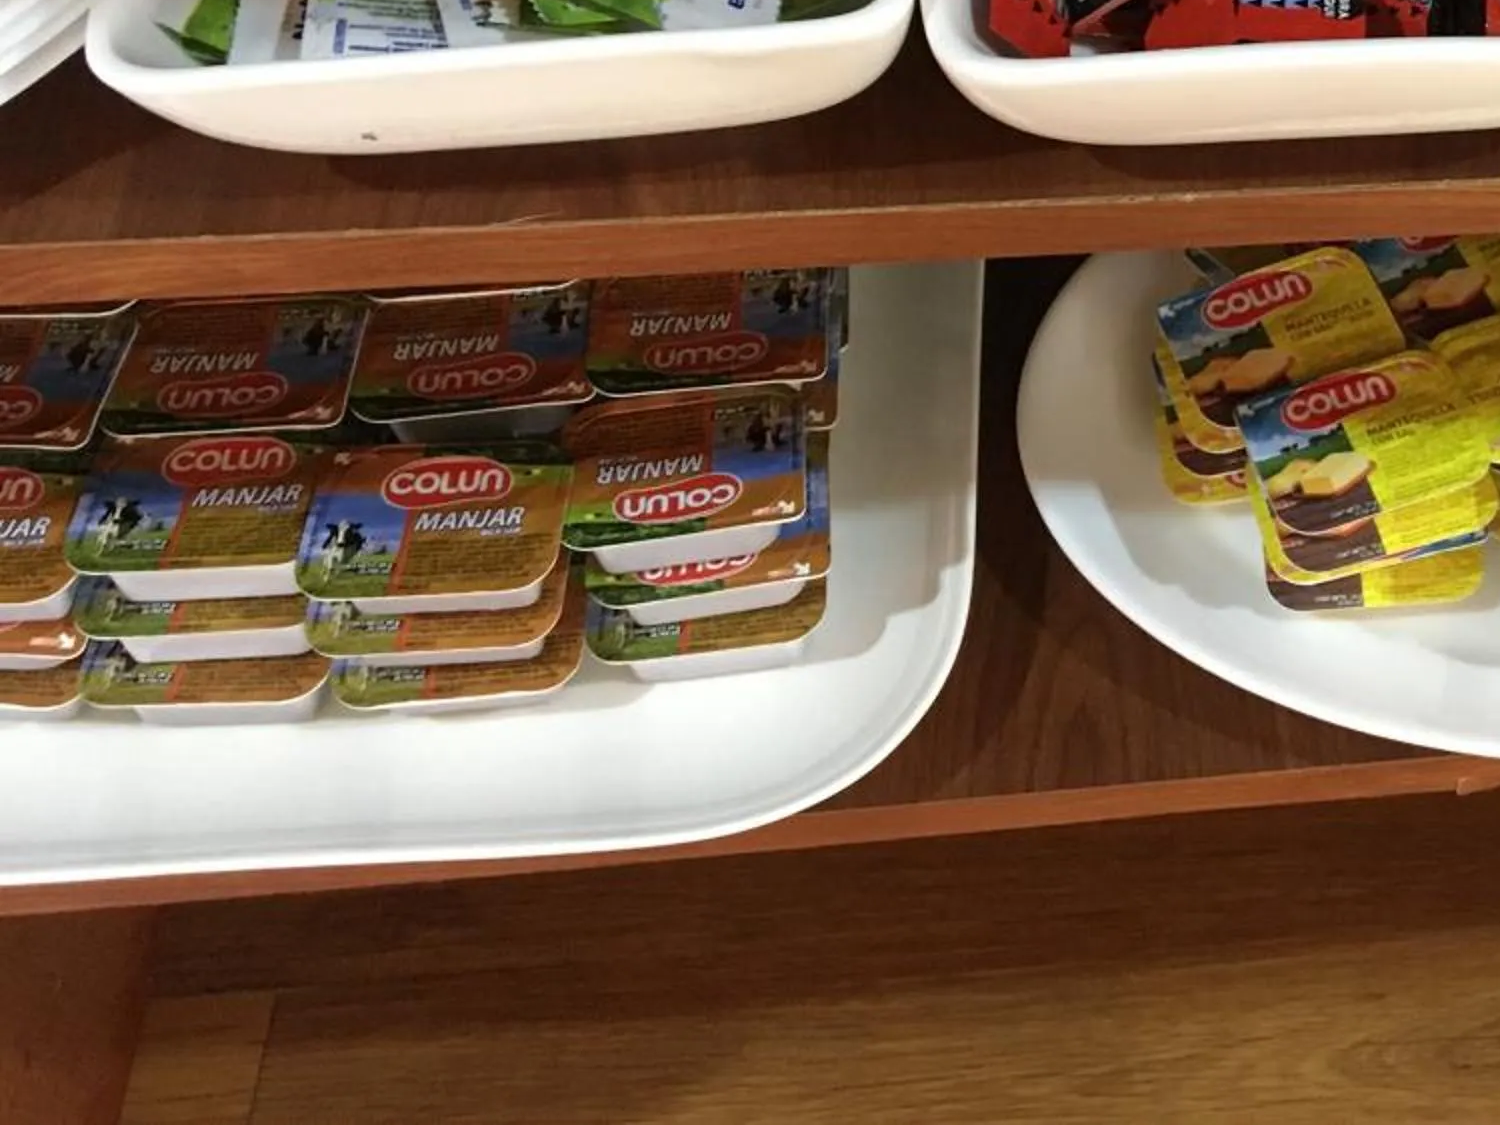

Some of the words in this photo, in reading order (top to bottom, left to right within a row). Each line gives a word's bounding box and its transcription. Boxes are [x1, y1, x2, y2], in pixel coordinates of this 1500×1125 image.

[1206, 273, 1306, 322] COLUN
[630, 311, 733, 337] MANJAR
[392, 333, 499, 361] MANJAR
[652, 341, 762, 369] COLUN
[150, 351, 261, 375] MANJAR
[417, 363, 530, 393] COLUN
[167, 383, 280, 410] COLUN
[1286, 375, 1390, 422] COLUN
[170, 444, 285, 472] COLUN
[596, 453, 704, 485] MANJAR
[192, 483, 304, 508] MANJAR
[388, 468, 504, 495] COLUN
[621, 483, 736, 517] COLUN
[414, 506, 525, 532] MANJAR
